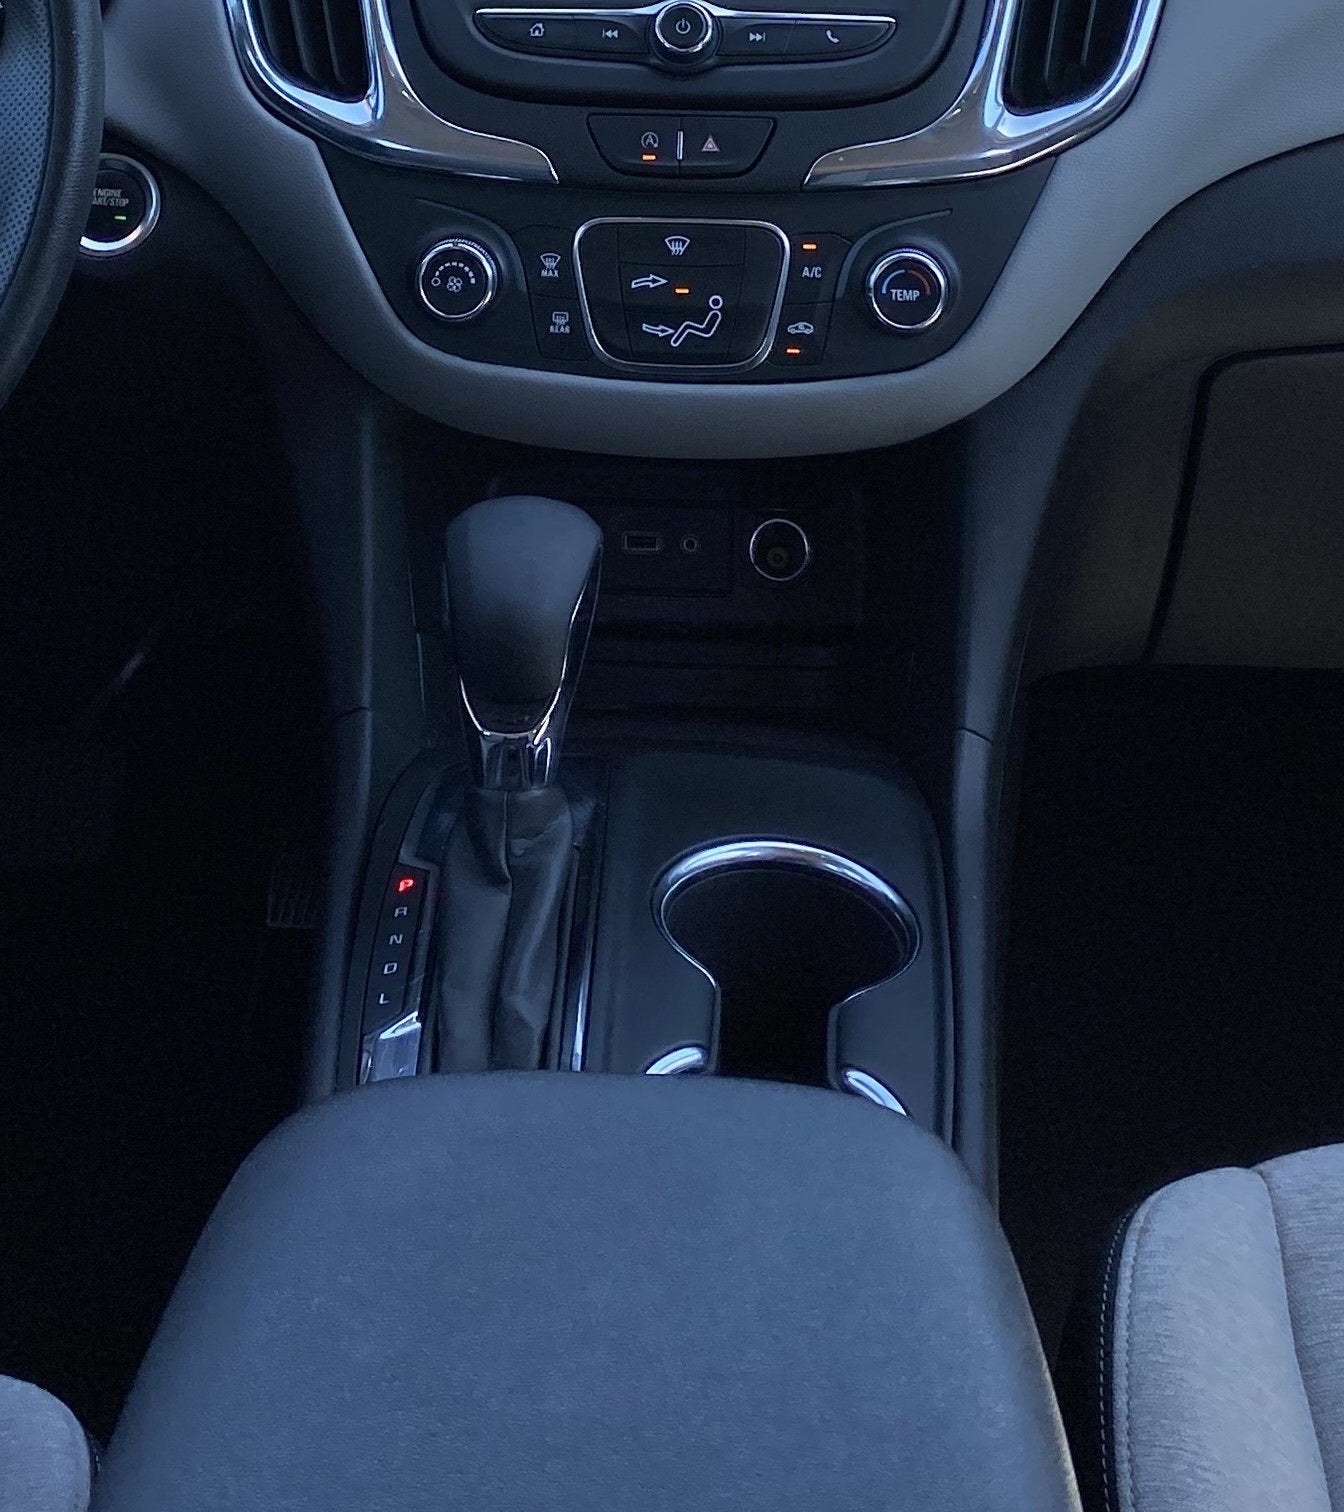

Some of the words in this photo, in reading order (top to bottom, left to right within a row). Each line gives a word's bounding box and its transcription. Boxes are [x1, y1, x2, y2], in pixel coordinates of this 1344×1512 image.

[91, 197, 130, 207] ART/STOP
[541, 269, 559, 278] MAX
[801, 266, 823, 279] A/C
[890, 289, 920, 302] TEMP
[398, 878, 414, 892] P
[389, 933, 403, 945] N
[383, 962, 398, 975] D
[379, 993, 389, 1004] L
